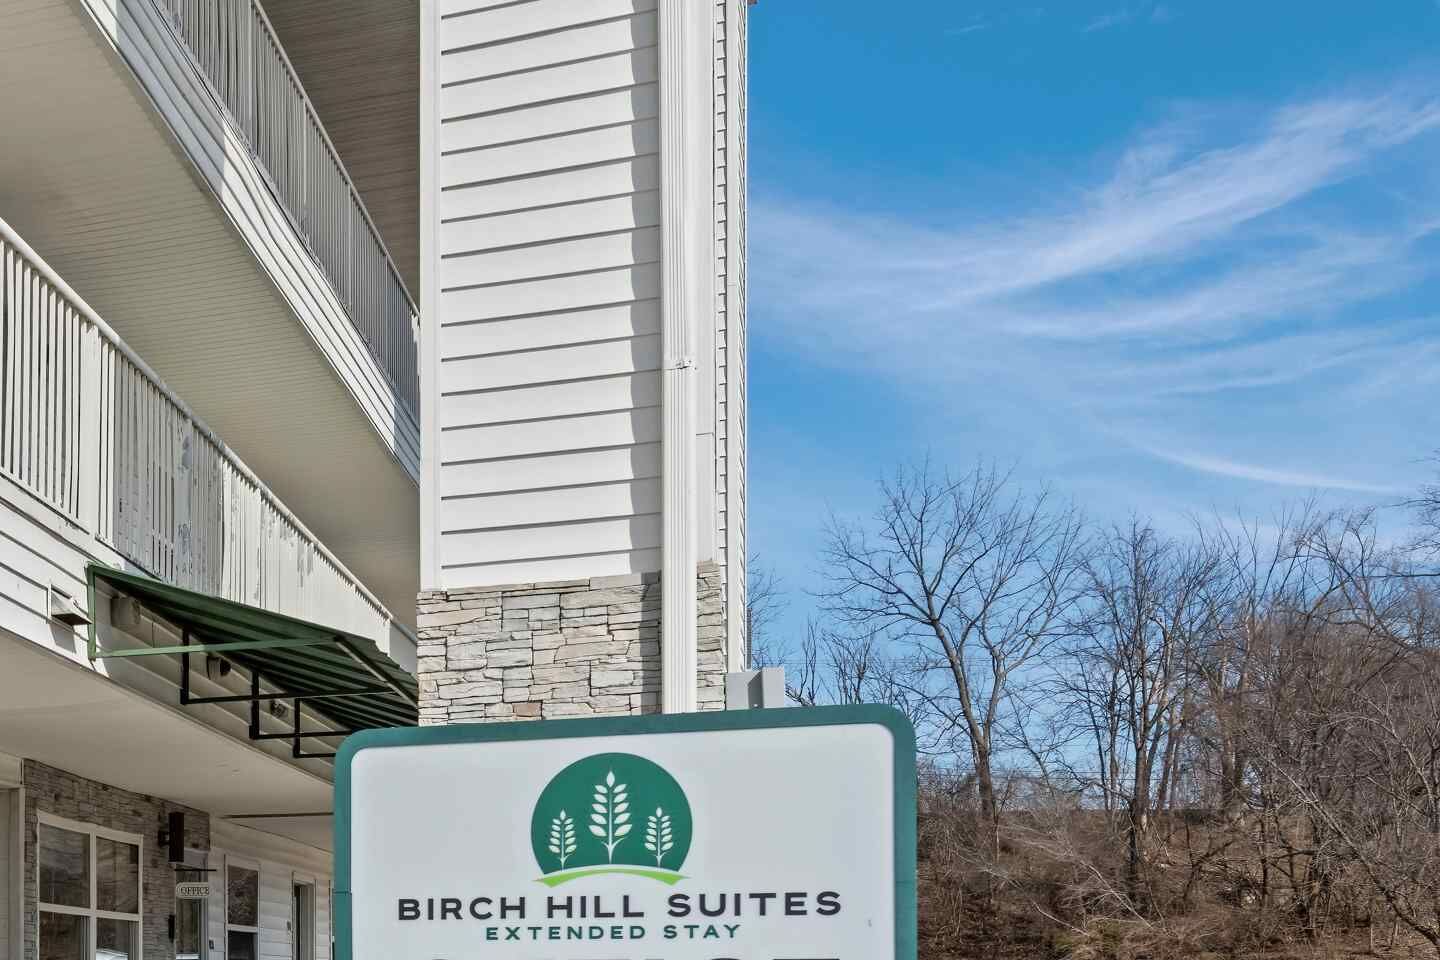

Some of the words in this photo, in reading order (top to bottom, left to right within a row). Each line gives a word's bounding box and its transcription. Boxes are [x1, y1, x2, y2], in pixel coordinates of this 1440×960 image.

[180, 886, 210, 896] OFFICE
[398, 896, 526, 921] BIRCH
[546, 895, 645, 919] HILL
[666, 890, 842, 918] SUITES
[485, 925, 646, 941] EXTENDED
[663, 924, 741, 940] STAY
